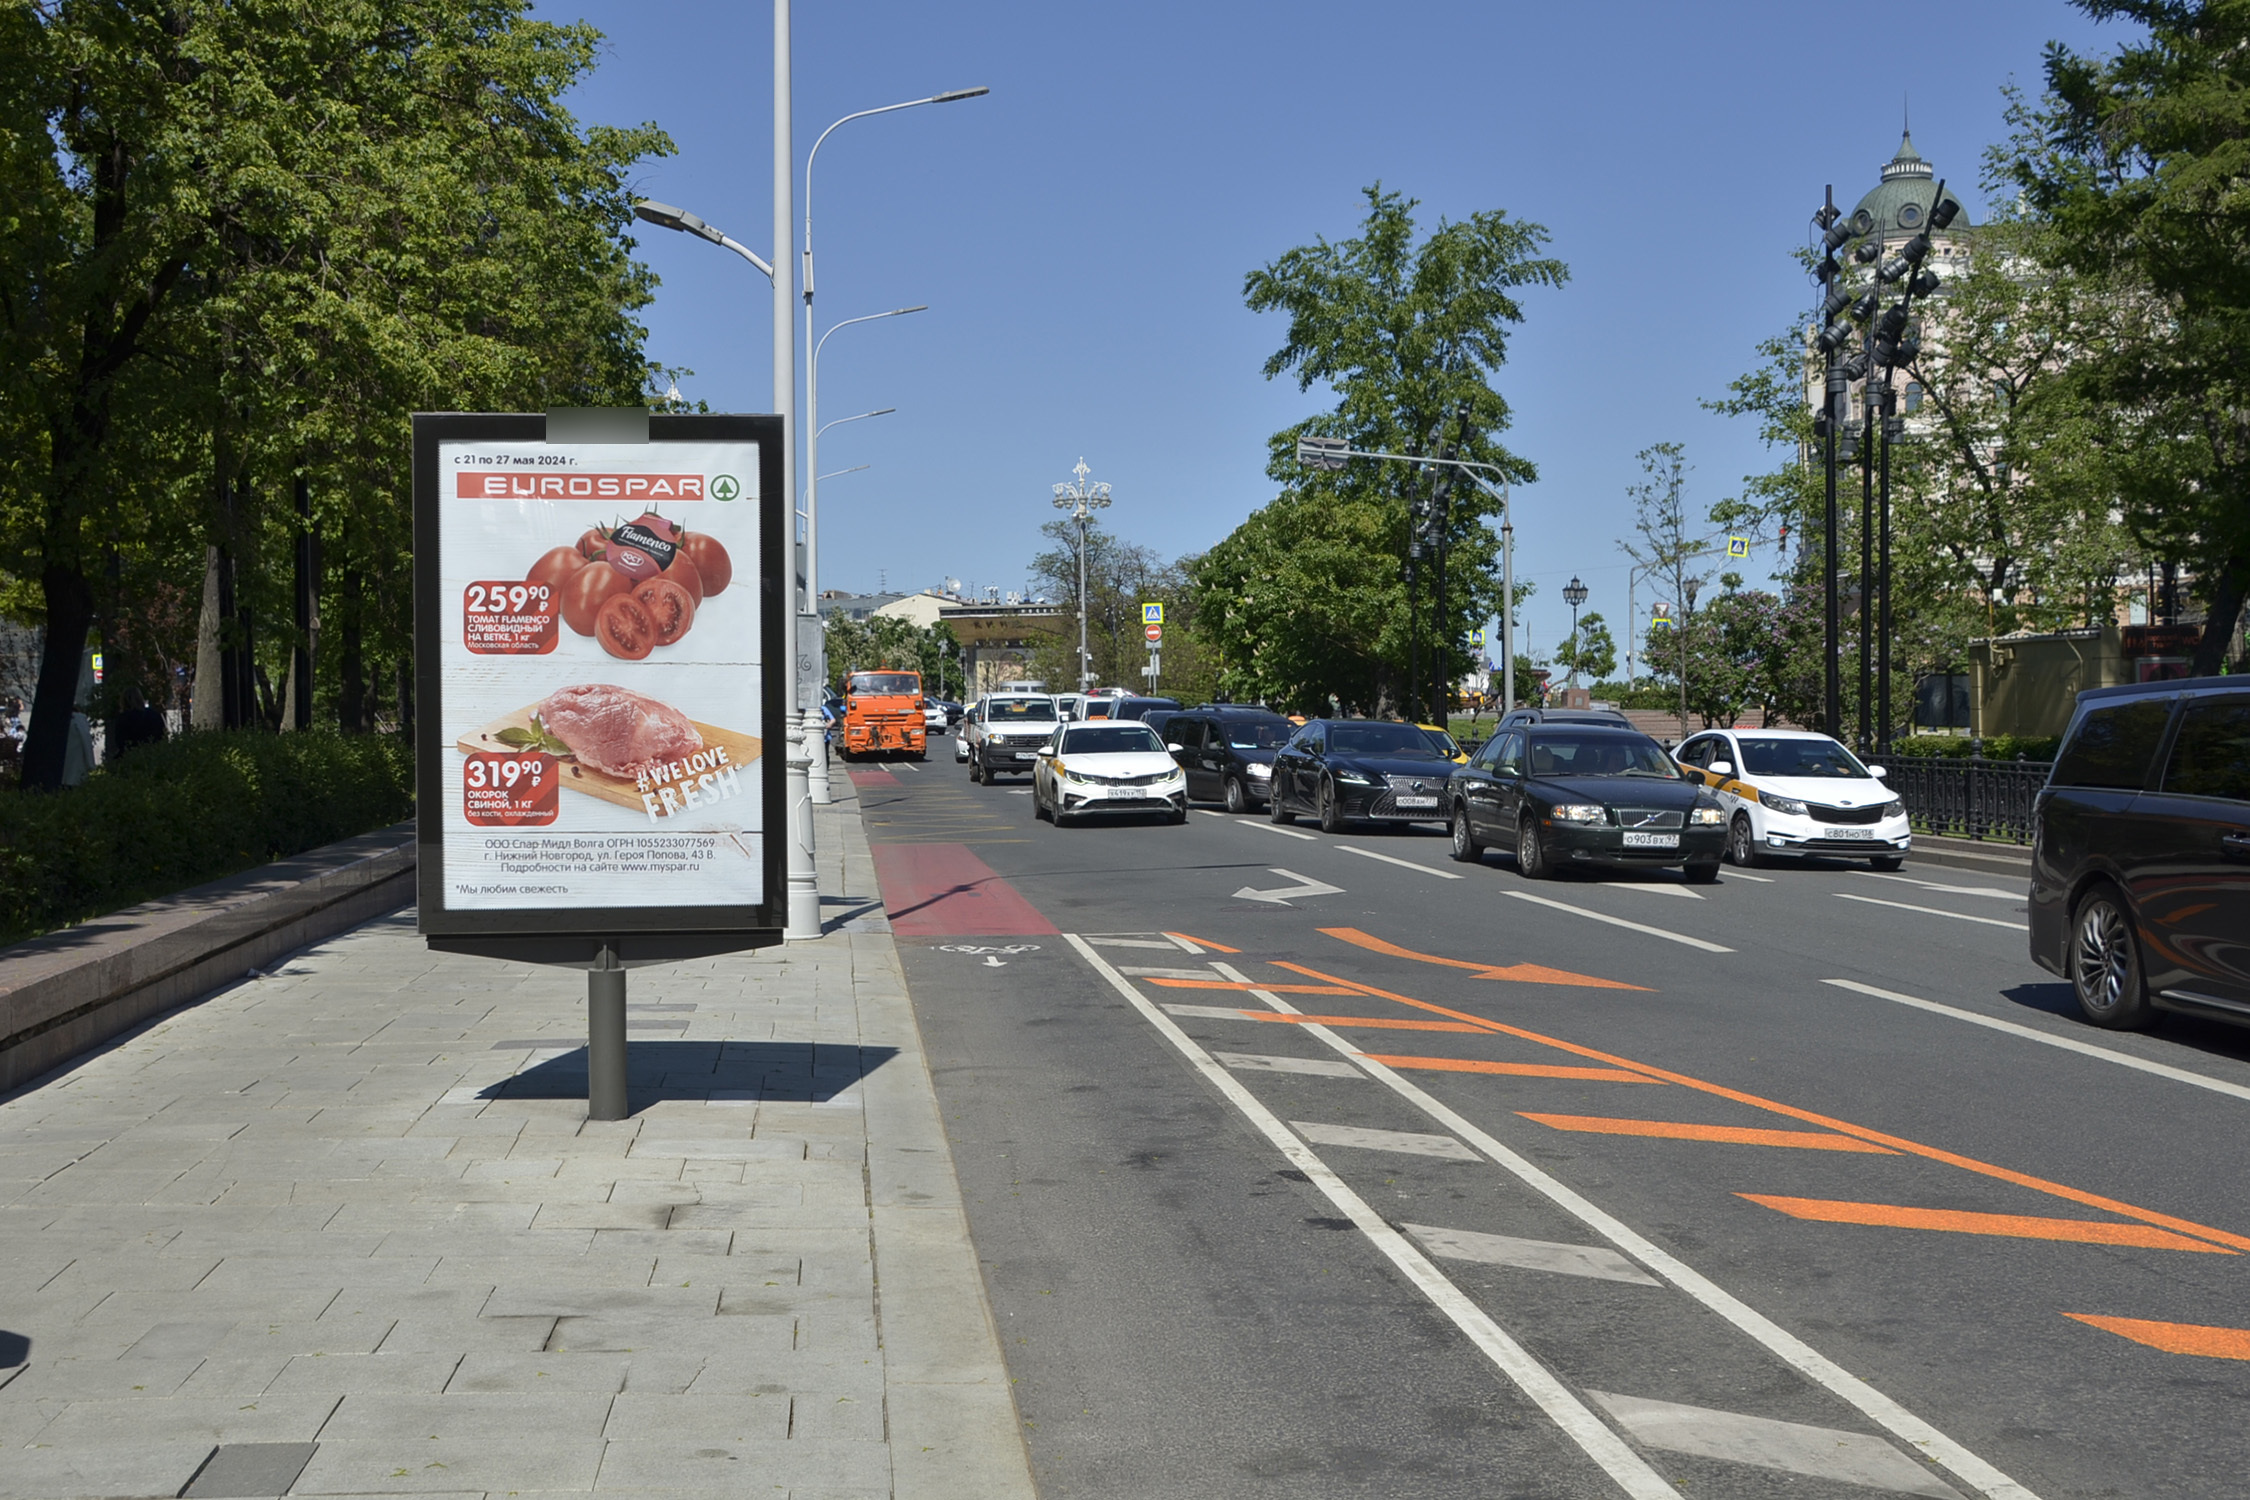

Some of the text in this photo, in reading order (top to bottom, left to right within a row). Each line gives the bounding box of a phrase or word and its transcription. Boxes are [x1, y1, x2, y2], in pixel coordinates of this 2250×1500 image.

[454, 455, 578, 465] с 21 по 27 мая 2024 г.
[484, 476, 702, 496] EUROSPAR
[621, 525, 672, 552] Flamenco
[467, 615, 550, 625] ТОМАТ FLAMENCO
[467, 623, 543, 634] СЛИВОВИДНЫЙ
[467, 633, 531, 642] НА ВЕТКЕ, 1 кг
[510, 641, 540, 649] область
[636, 746, 729, 793] #WE LOVE
[467, 790, 509, 799] ОКОРОК
[467, 799, 533, 810] СВИНОЙ, 1 КГ
[481, 810, 503, 818] кости,
[504, 810, 554, 818] охлажденный
[485, 838, 715, 851] ООО Спар Мидл Волга ОГРН 1055233077569
[484, 850, 716, 861] г. Нижний Новгород, ул. Героя Попова, 43 В.
[501, 862, 700, 873] Подробности на сайте www.myspar.ru
[480, 885, 517, 894] любим
[519, 885, 569, 894] свежесть
